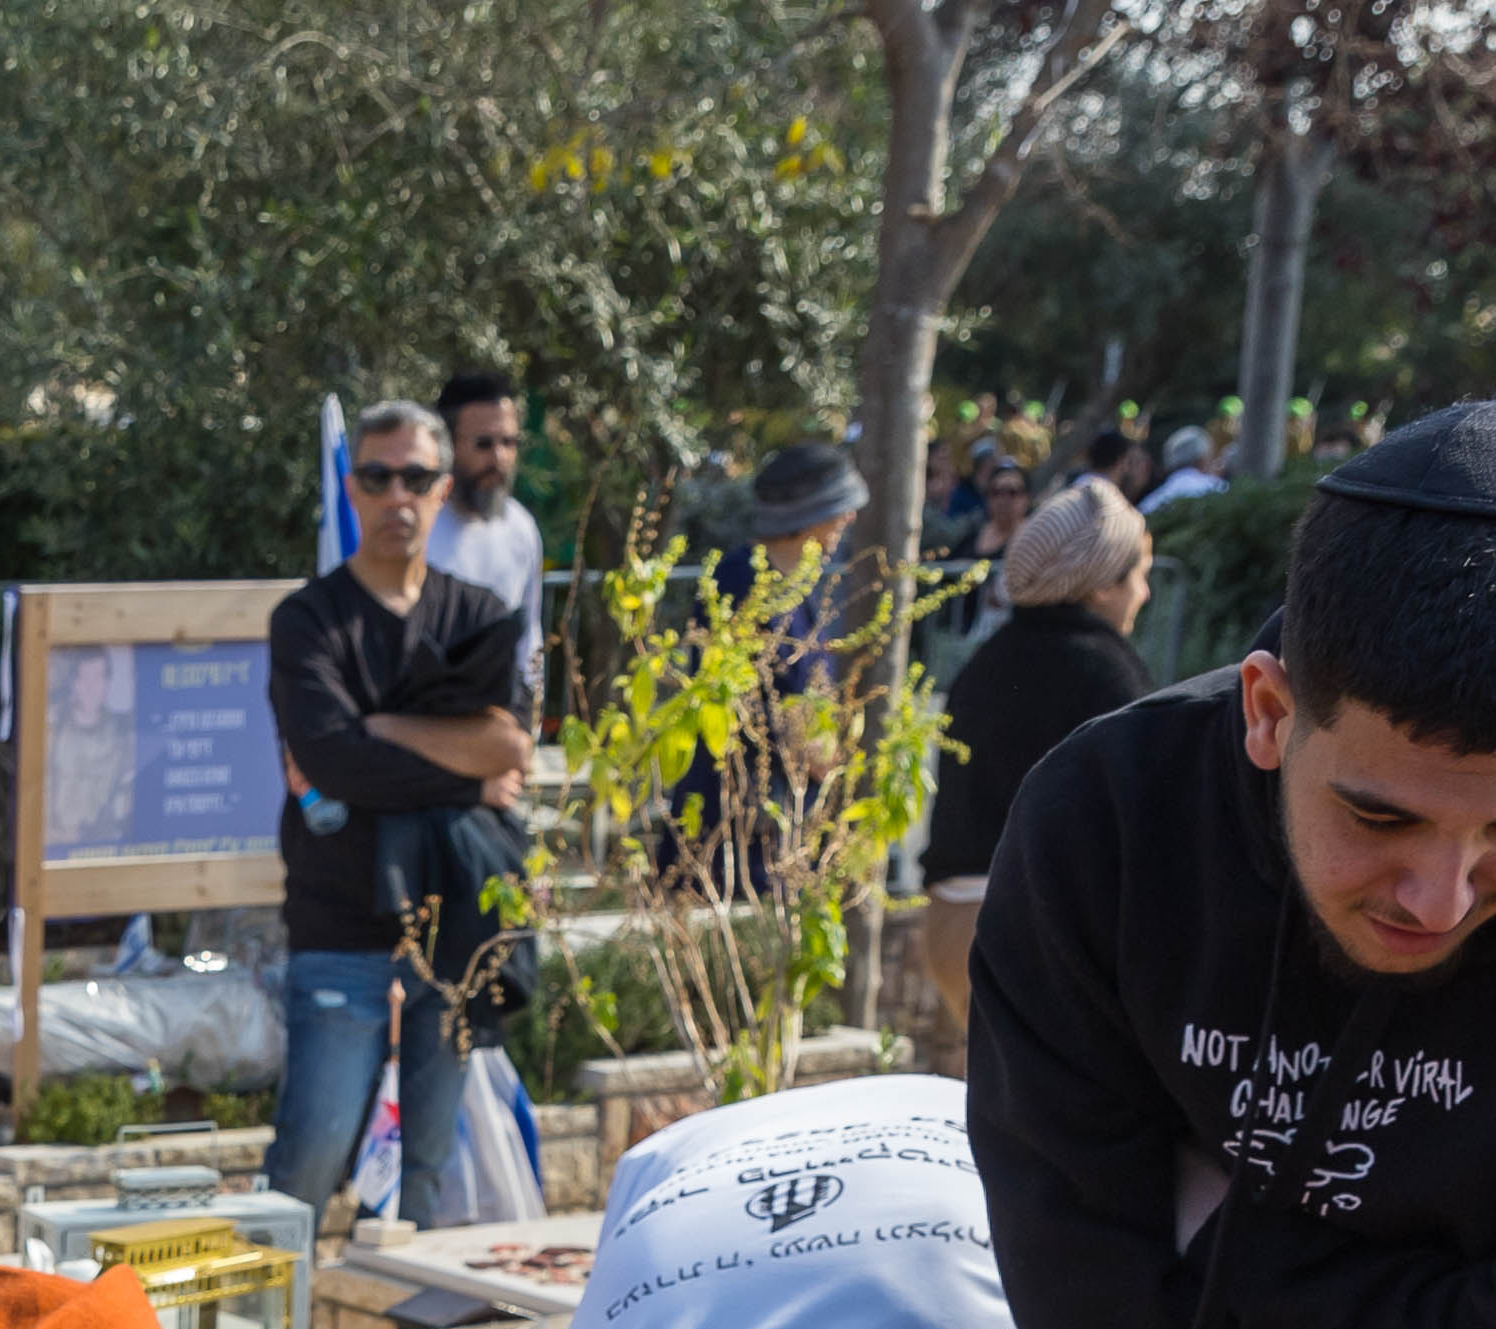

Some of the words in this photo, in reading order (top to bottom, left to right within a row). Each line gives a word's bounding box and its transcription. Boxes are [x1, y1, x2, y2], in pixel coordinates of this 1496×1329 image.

[1181, 1023, 1250, 1072] NOT
[605, 1261, 704, 1321] בעזרת
[770, 1229, 861, 1258] נעשה
